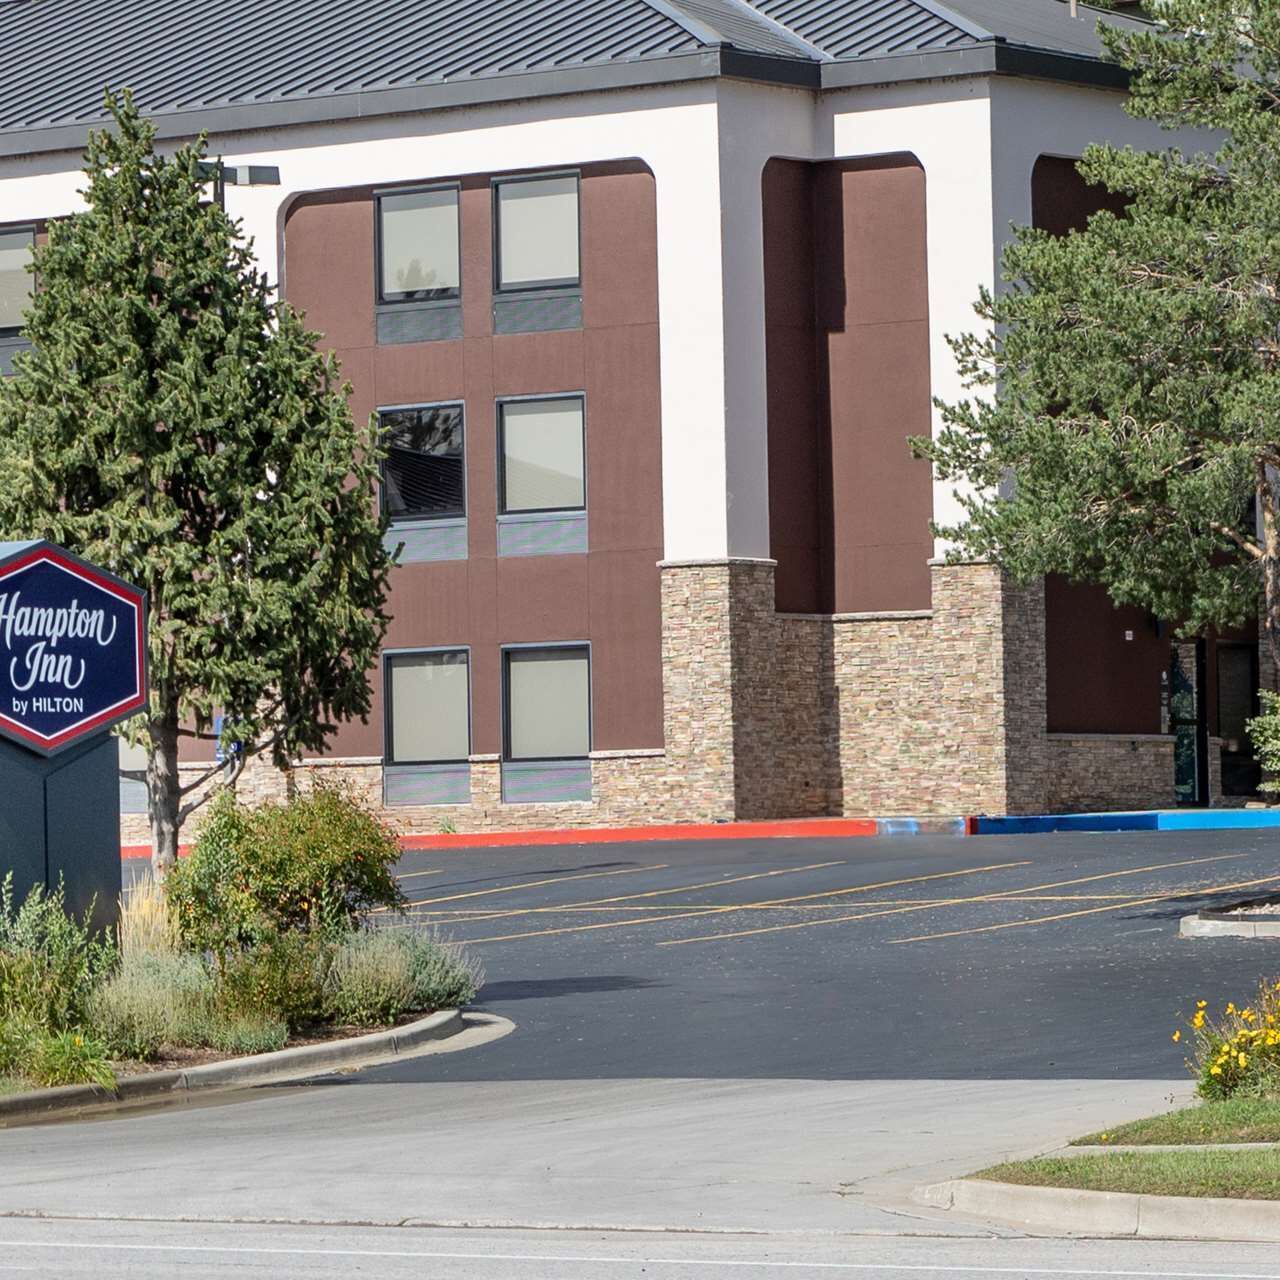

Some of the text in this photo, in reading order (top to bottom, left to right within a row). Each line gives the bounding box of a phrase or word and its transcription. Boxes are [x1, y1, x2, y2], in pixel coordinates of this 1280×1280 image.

[10, 641, 85, 691] Inn
[12, 697, 84, 715] by HILTON
